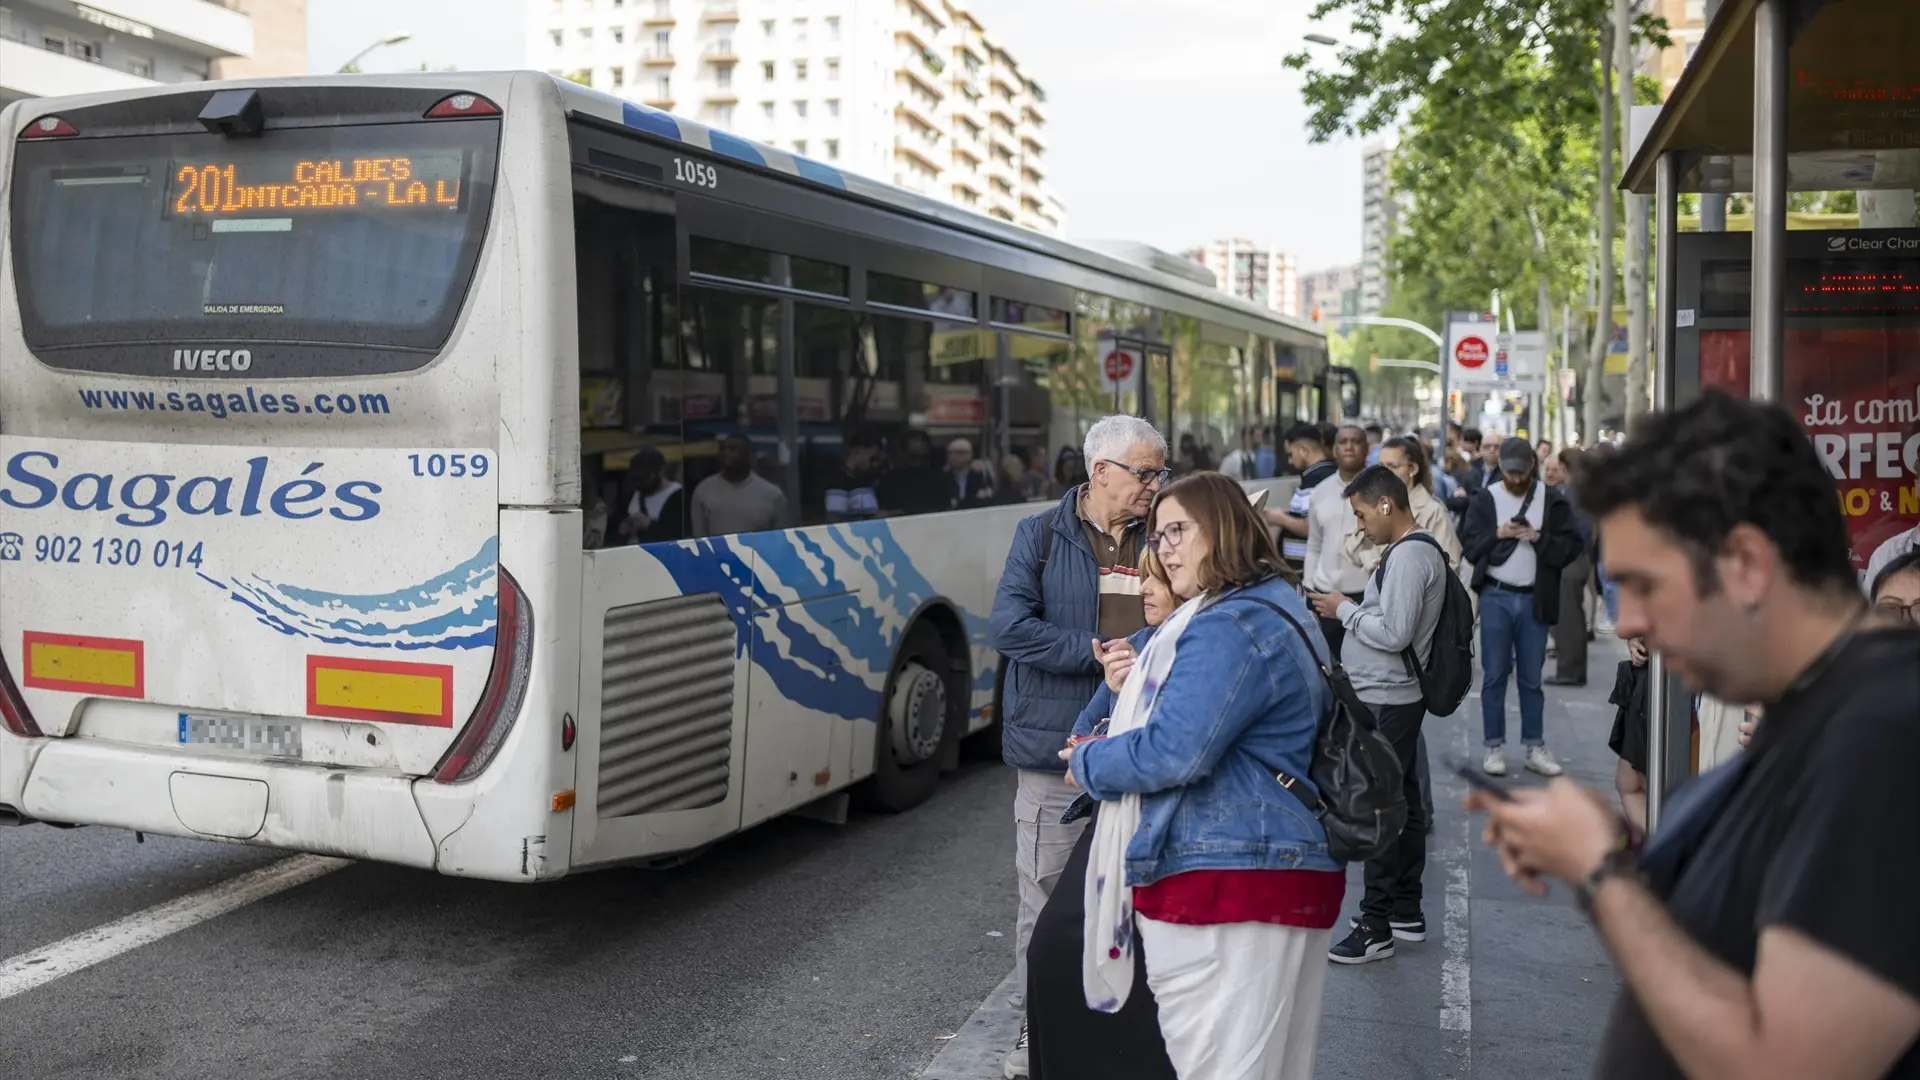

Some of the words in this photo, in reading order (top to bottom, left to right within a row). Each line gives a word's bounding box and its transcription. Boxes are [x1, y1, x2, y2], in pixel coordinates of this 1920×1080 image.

[296, 158, 411, 184] CALDES
[674, 157, 717, 189] 1059
[177, 164, 236, 212] 201
[388, 181, 427, 204] LA
[1848, 237, 1885, 249] Clear
[204, 305, 228, 313] SALIDA
[229, 305, 239, 313] DE
[239, 305, 284, 313] EMERGENCIA
[173, 349, 252, 371] IVECO
[78, 386, 391, 419] www.sagales.com
[1804, 393, 1848, 426] La
[407, 453, 489, 477] 1059
[1806, 431, 1920, 480] RFEC
[0, 450, 382, 527] Sagalés
[1880, 490, 1893, 511] &
[34, 535, 82, 563] 902
[92, 537, 142, 566] 130
[153, 540, 204, 569] 014
